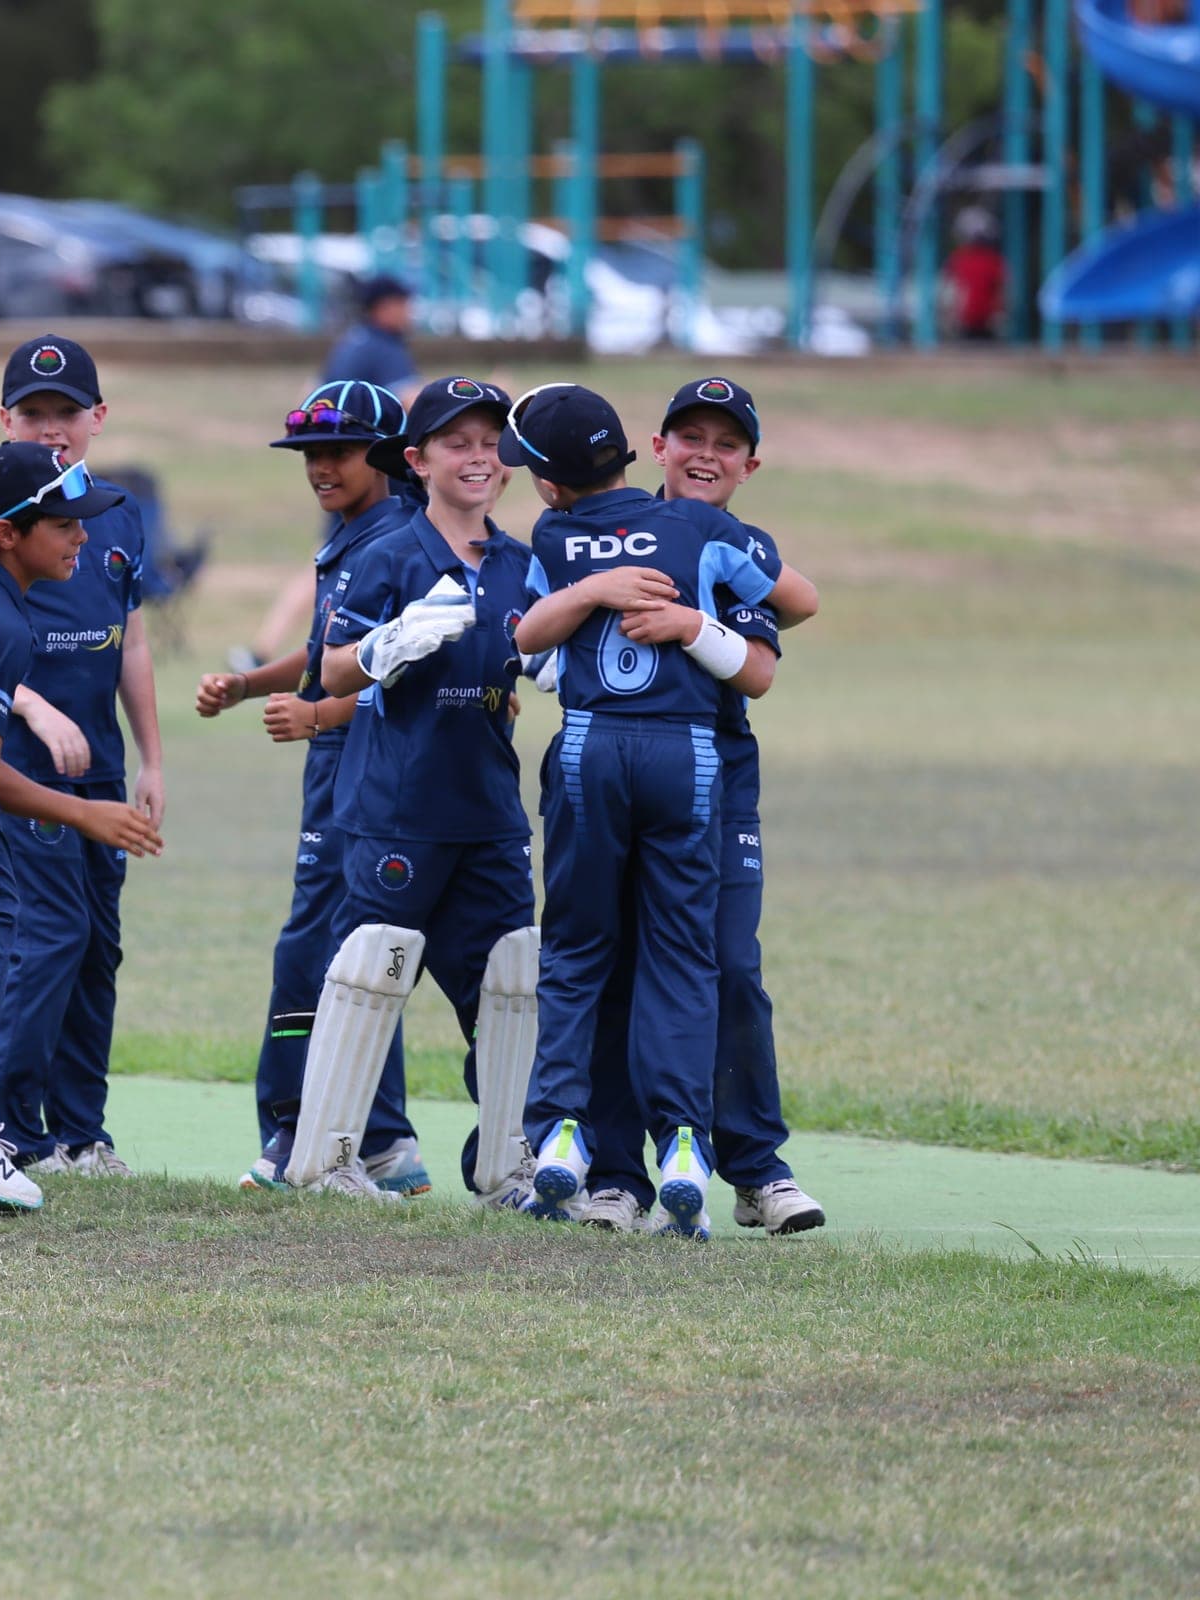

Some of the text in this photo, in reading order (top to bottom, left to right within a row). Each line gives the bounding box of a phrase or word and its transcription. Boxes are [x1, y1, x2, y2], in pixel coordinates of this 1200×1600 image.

[565, 531, 658, 561] FDC
[46, 630, 107, 642] mounties
[46, 641, 78, 653] group
[435, 698, 467, 709] group
